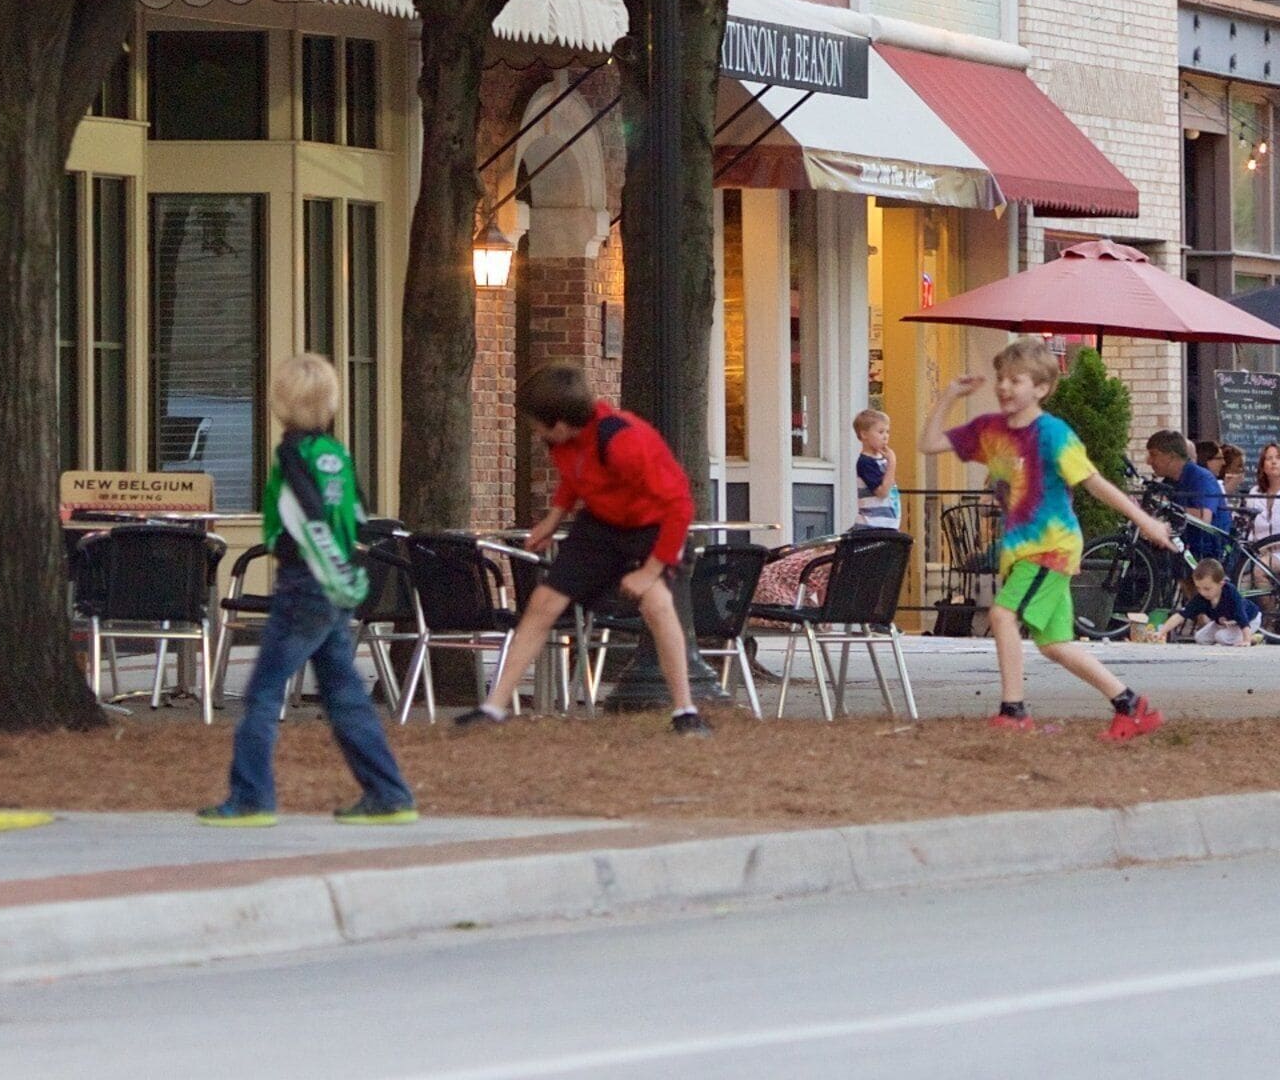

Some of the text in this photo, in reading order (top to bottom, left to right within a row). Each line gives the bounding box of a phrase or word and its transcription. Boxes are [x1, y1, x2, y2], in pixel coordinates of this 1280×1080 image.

[781, 35, 791, 81] &
[794, 33, 843, 87] BEASON
[74, 479, 194, 492] NEW BELGIUM
[98, 493, 162, 502] BREWING
